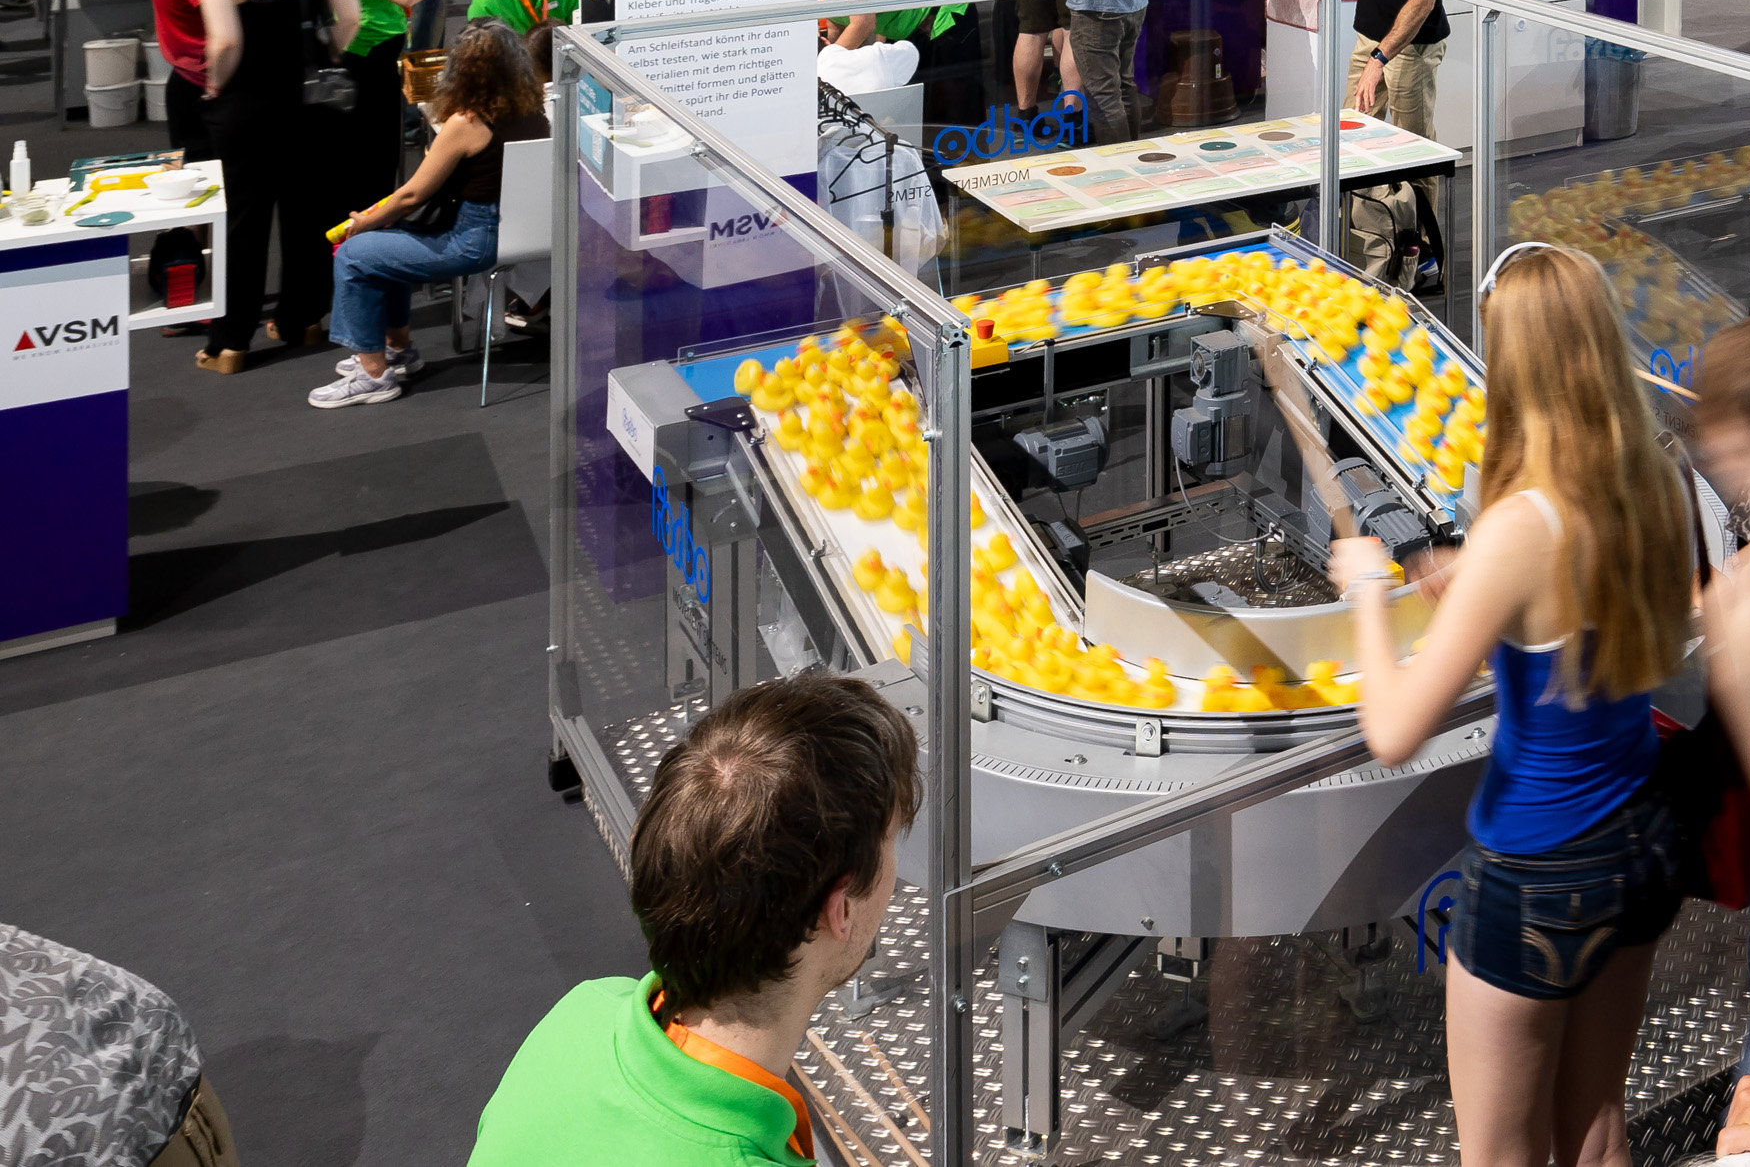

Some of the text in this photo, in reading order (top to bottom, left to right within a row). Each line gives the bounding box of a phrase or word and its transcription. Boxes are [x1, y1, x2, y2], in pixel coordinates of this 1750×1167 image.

[628, 0, 662, 11] Kleber
[628, 28, 790, 55] Am Schleifstand könnt ihr dann
[35, 315, 119, 346] VSM
